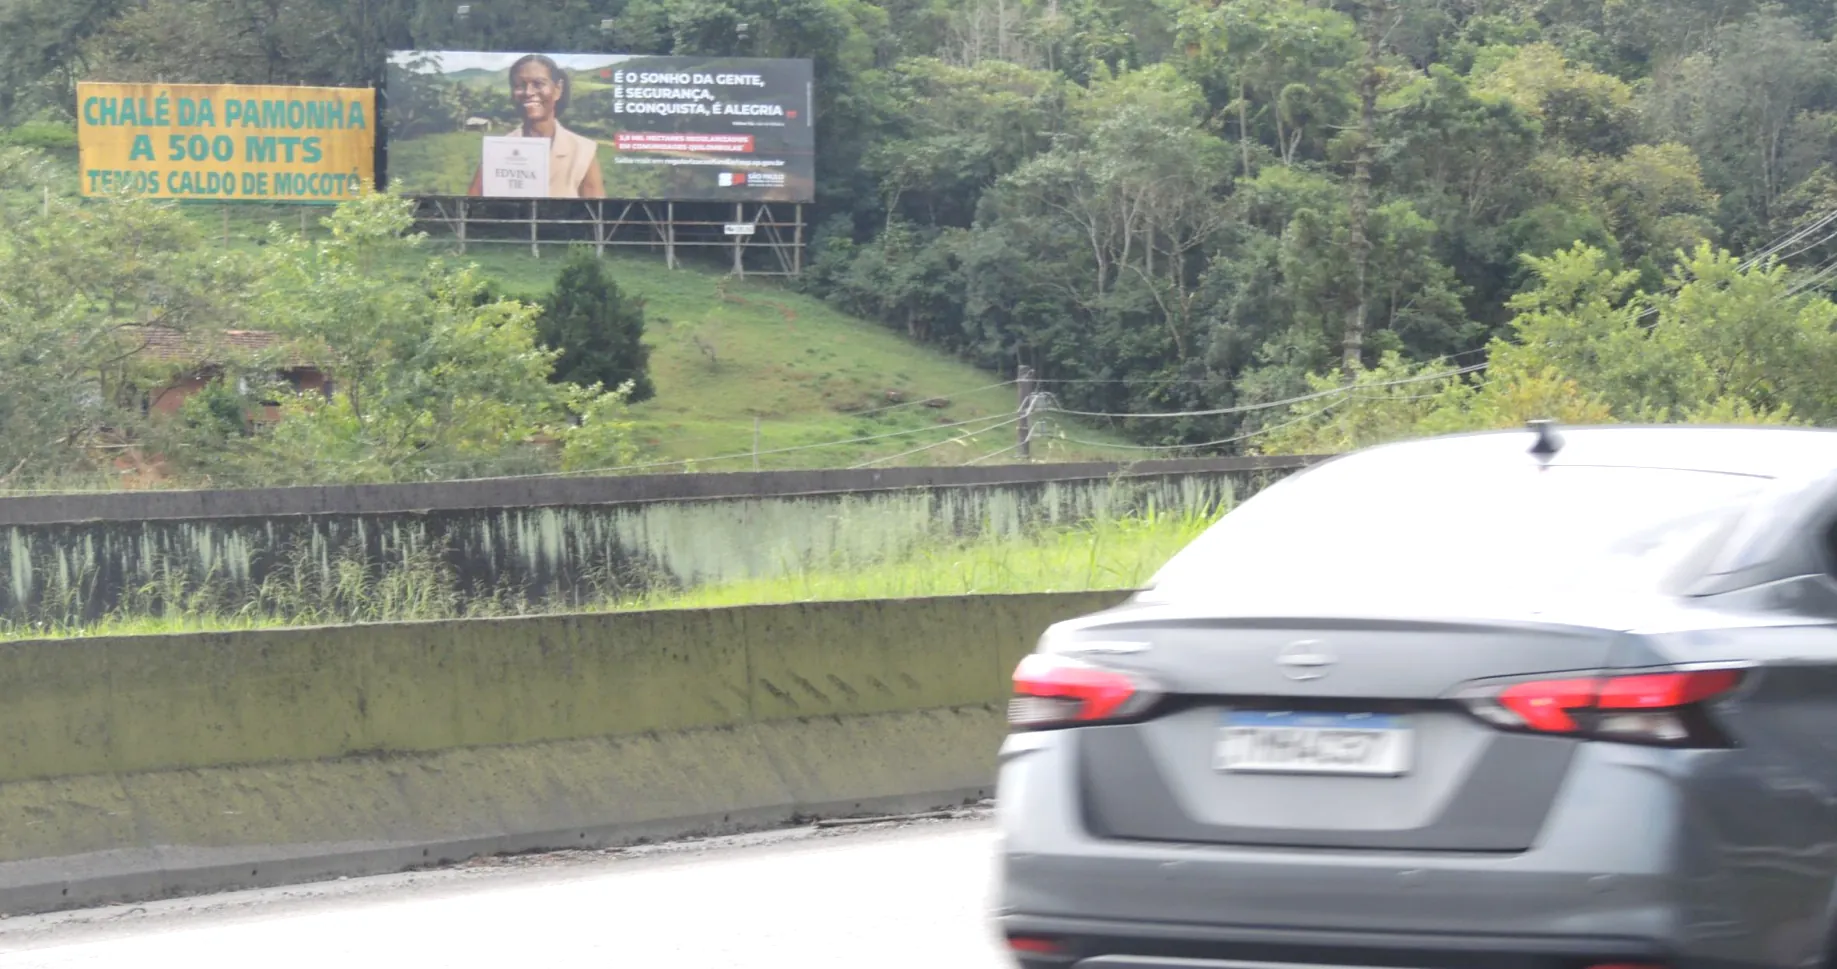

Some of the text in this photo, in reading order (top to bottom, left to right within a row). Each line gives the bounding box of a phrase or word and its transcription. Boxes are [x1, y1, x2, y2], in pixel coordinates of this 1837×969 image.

[614, 69, 766, 88] É O SONHO DA GENTE,
[614, 84, 715, 102] É SEGURANÇA,
[83, 90, 366, 130] CHALÉ DA PAMONHA
[614, 99, 784, 117] É CONQUISTA, É ALEGRIA
[128, 134, 323, 163] A 500 MTS
[166, 170, 236, 195] CALDO
[242, 171, 268, 195] DE
